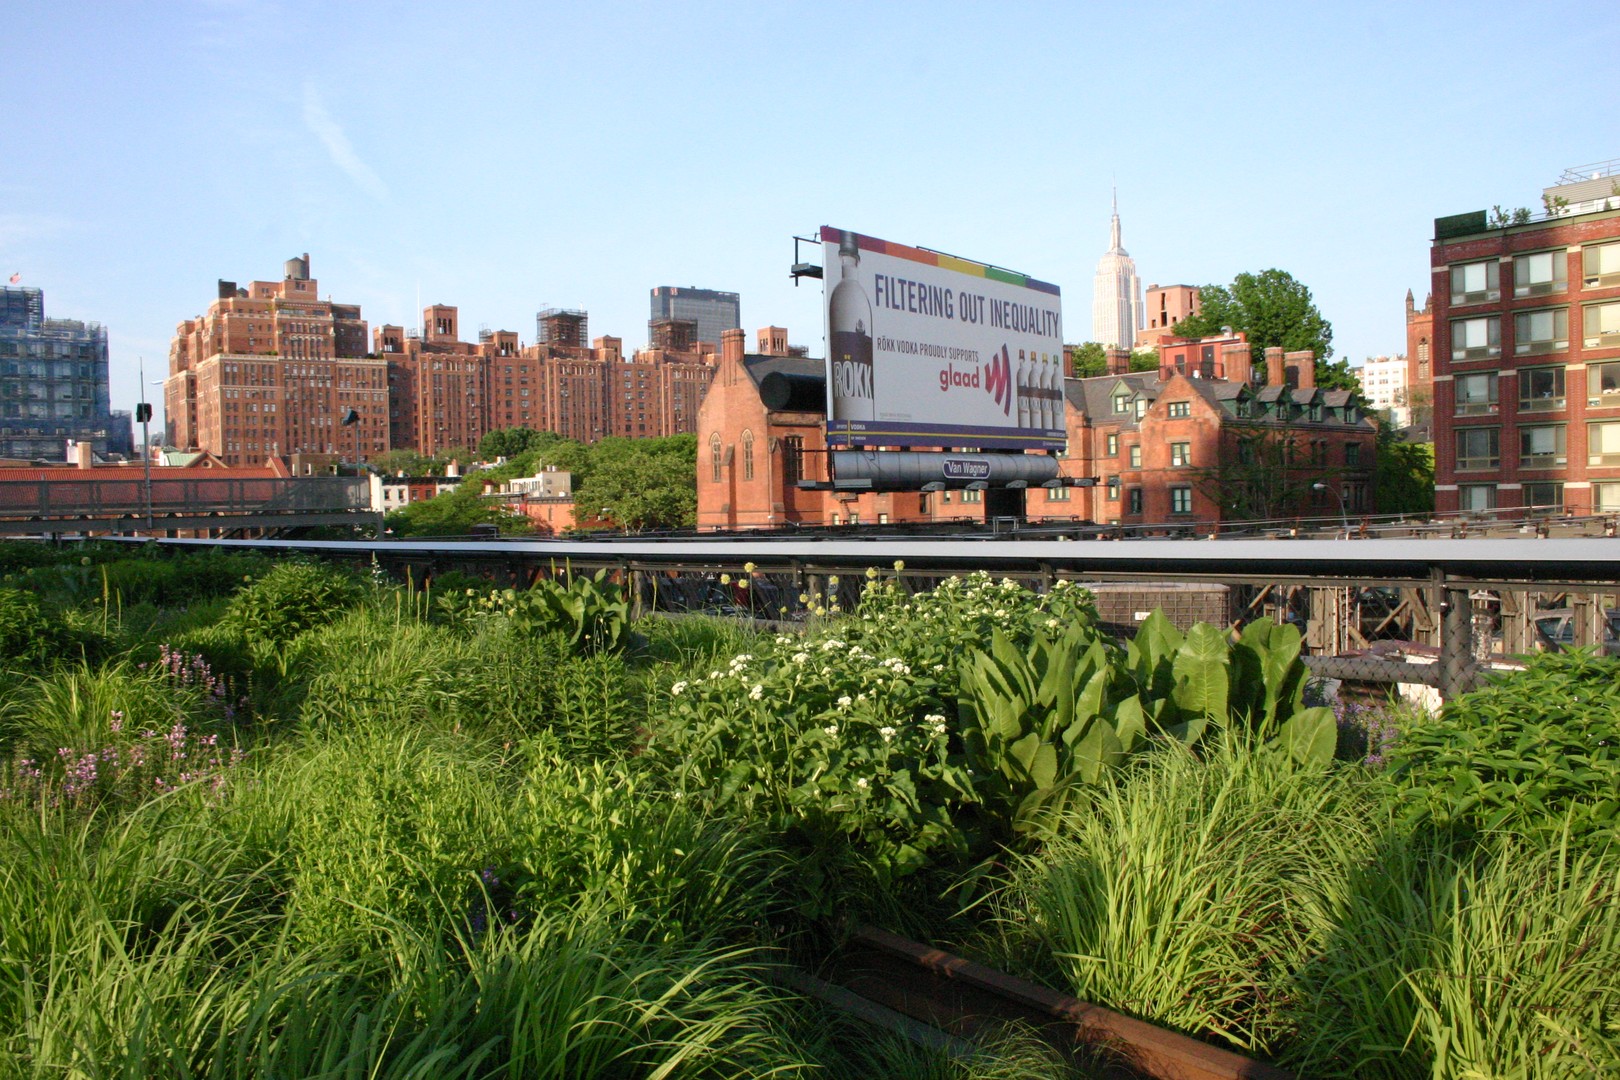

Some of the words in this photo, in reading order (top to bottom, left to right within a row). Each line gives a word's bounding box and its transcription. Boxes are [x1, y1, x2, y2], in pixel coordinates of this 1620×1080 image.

[874, 273, 954, 320] FILTERING
[959, 291, 985, 325] OUT
[990, 297, 1059, 338] INEQUALITY
[896, 340, 918, 355] VODKA
[919, 343, 948, 359] PROUDLY
[948, 347, 979, 363] SUPPORTS
[833, 354, 873, 400] RÖKK
[940, 362, 980, 392] glaad
[944, 461, 962, 474] Van
[962, 461, 988, 477] Wagner
